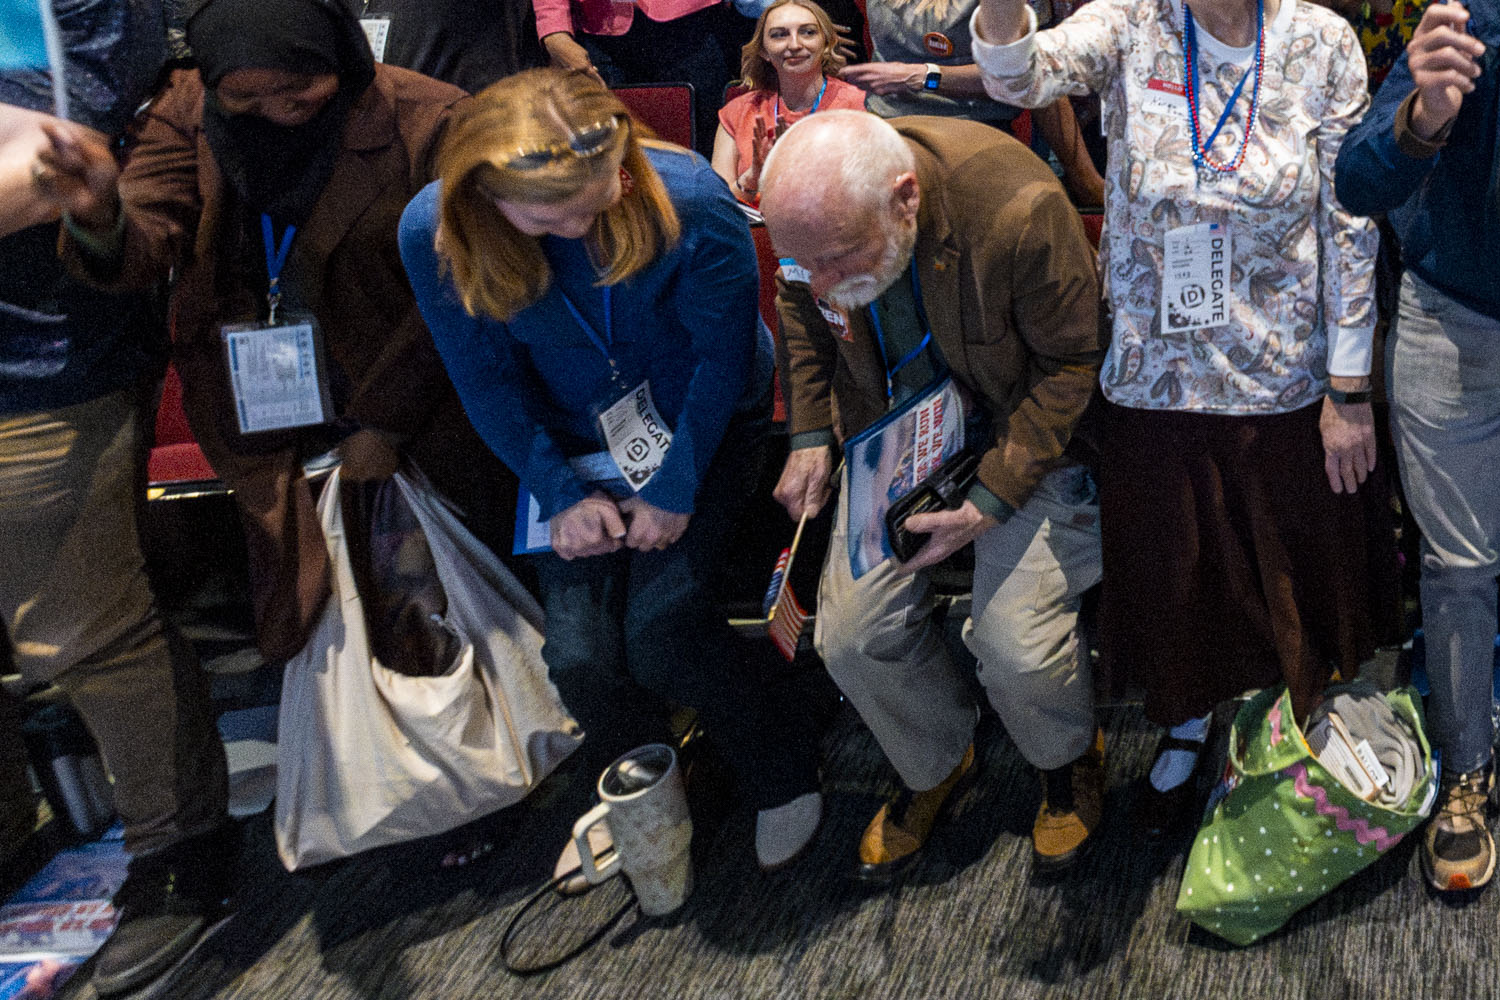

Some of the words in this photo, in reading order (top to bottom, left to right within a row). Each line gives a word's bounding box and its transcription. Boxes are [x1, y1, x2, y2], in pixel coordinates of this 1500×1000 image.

[1211, 237, 1224, 322] DELEGATE
[636, 388, 671, 454] DELEGAT
[919, 408, 929, 437] RUN
